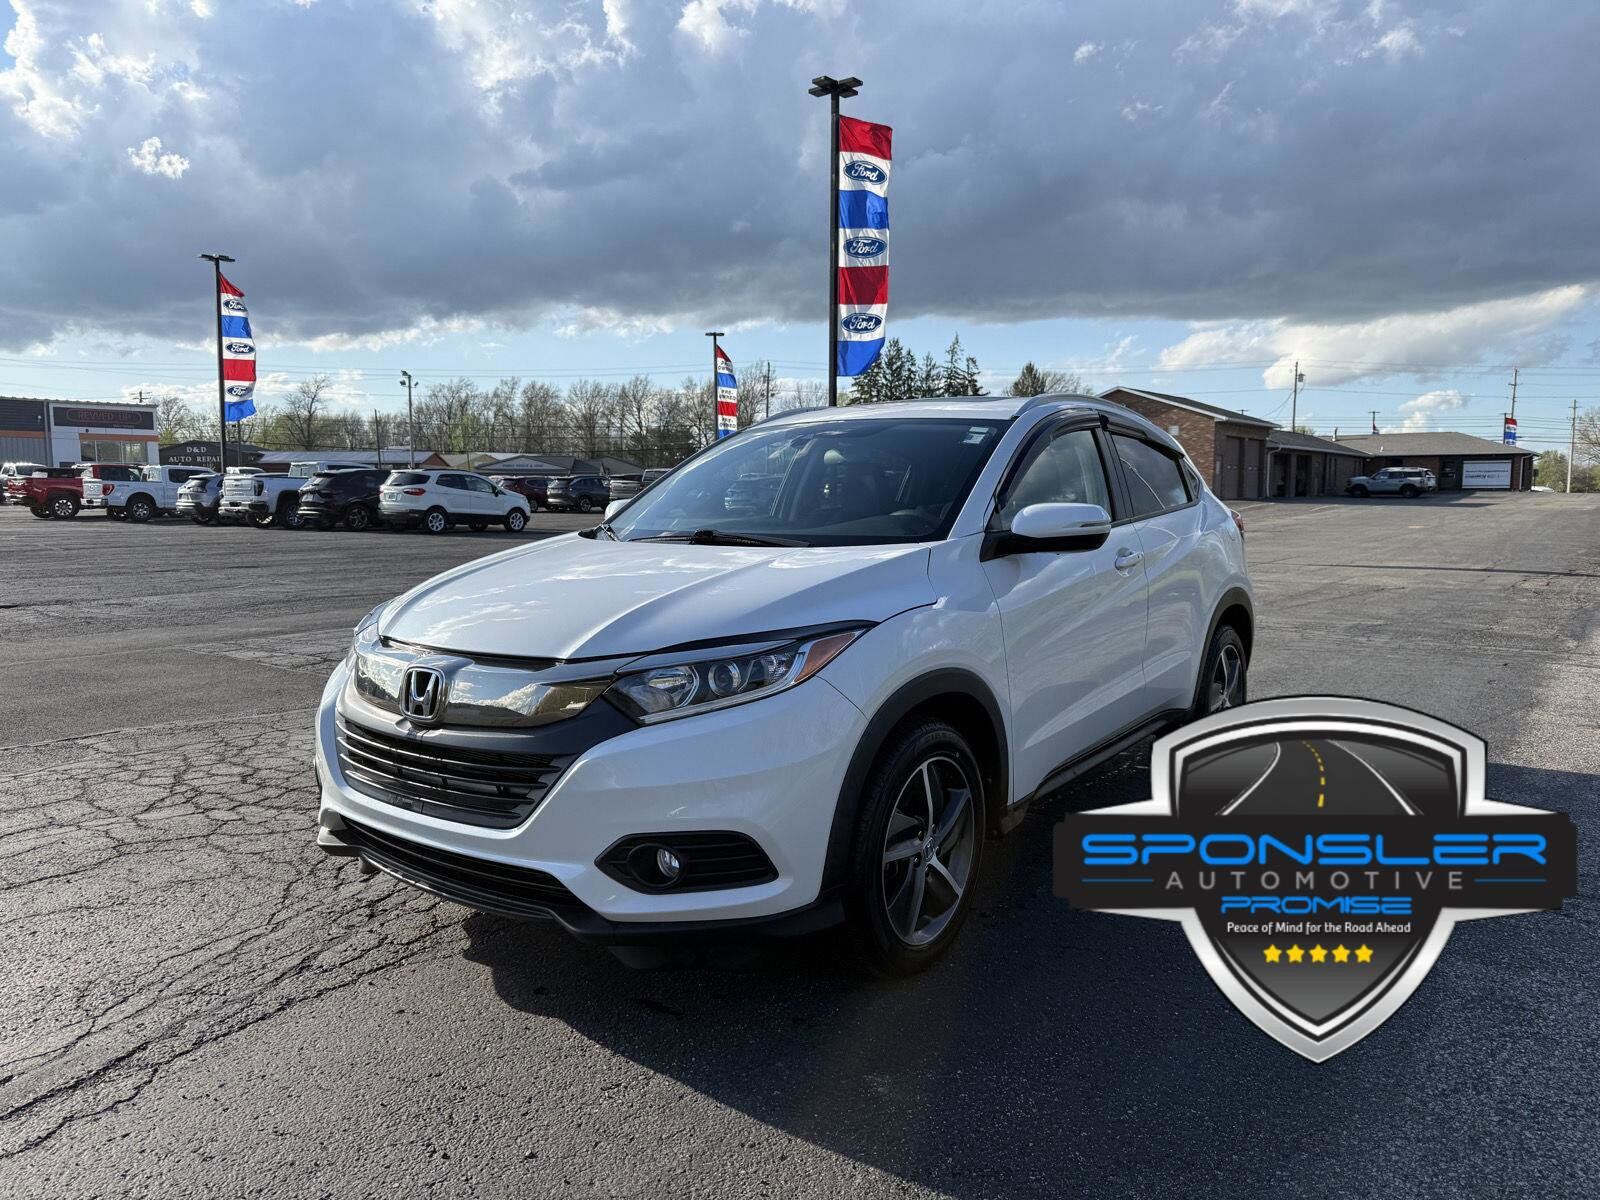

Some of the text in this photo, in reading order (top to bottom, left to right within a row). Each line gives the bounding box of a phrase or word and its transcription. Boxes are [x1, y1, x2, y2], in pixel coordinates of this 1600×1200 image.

[851, 162, 879, 181] Ford
[849, 239, 879, 254] Ford
[849, 315, 876, 330] Ford
[231, 343, 250, 353] Ford
